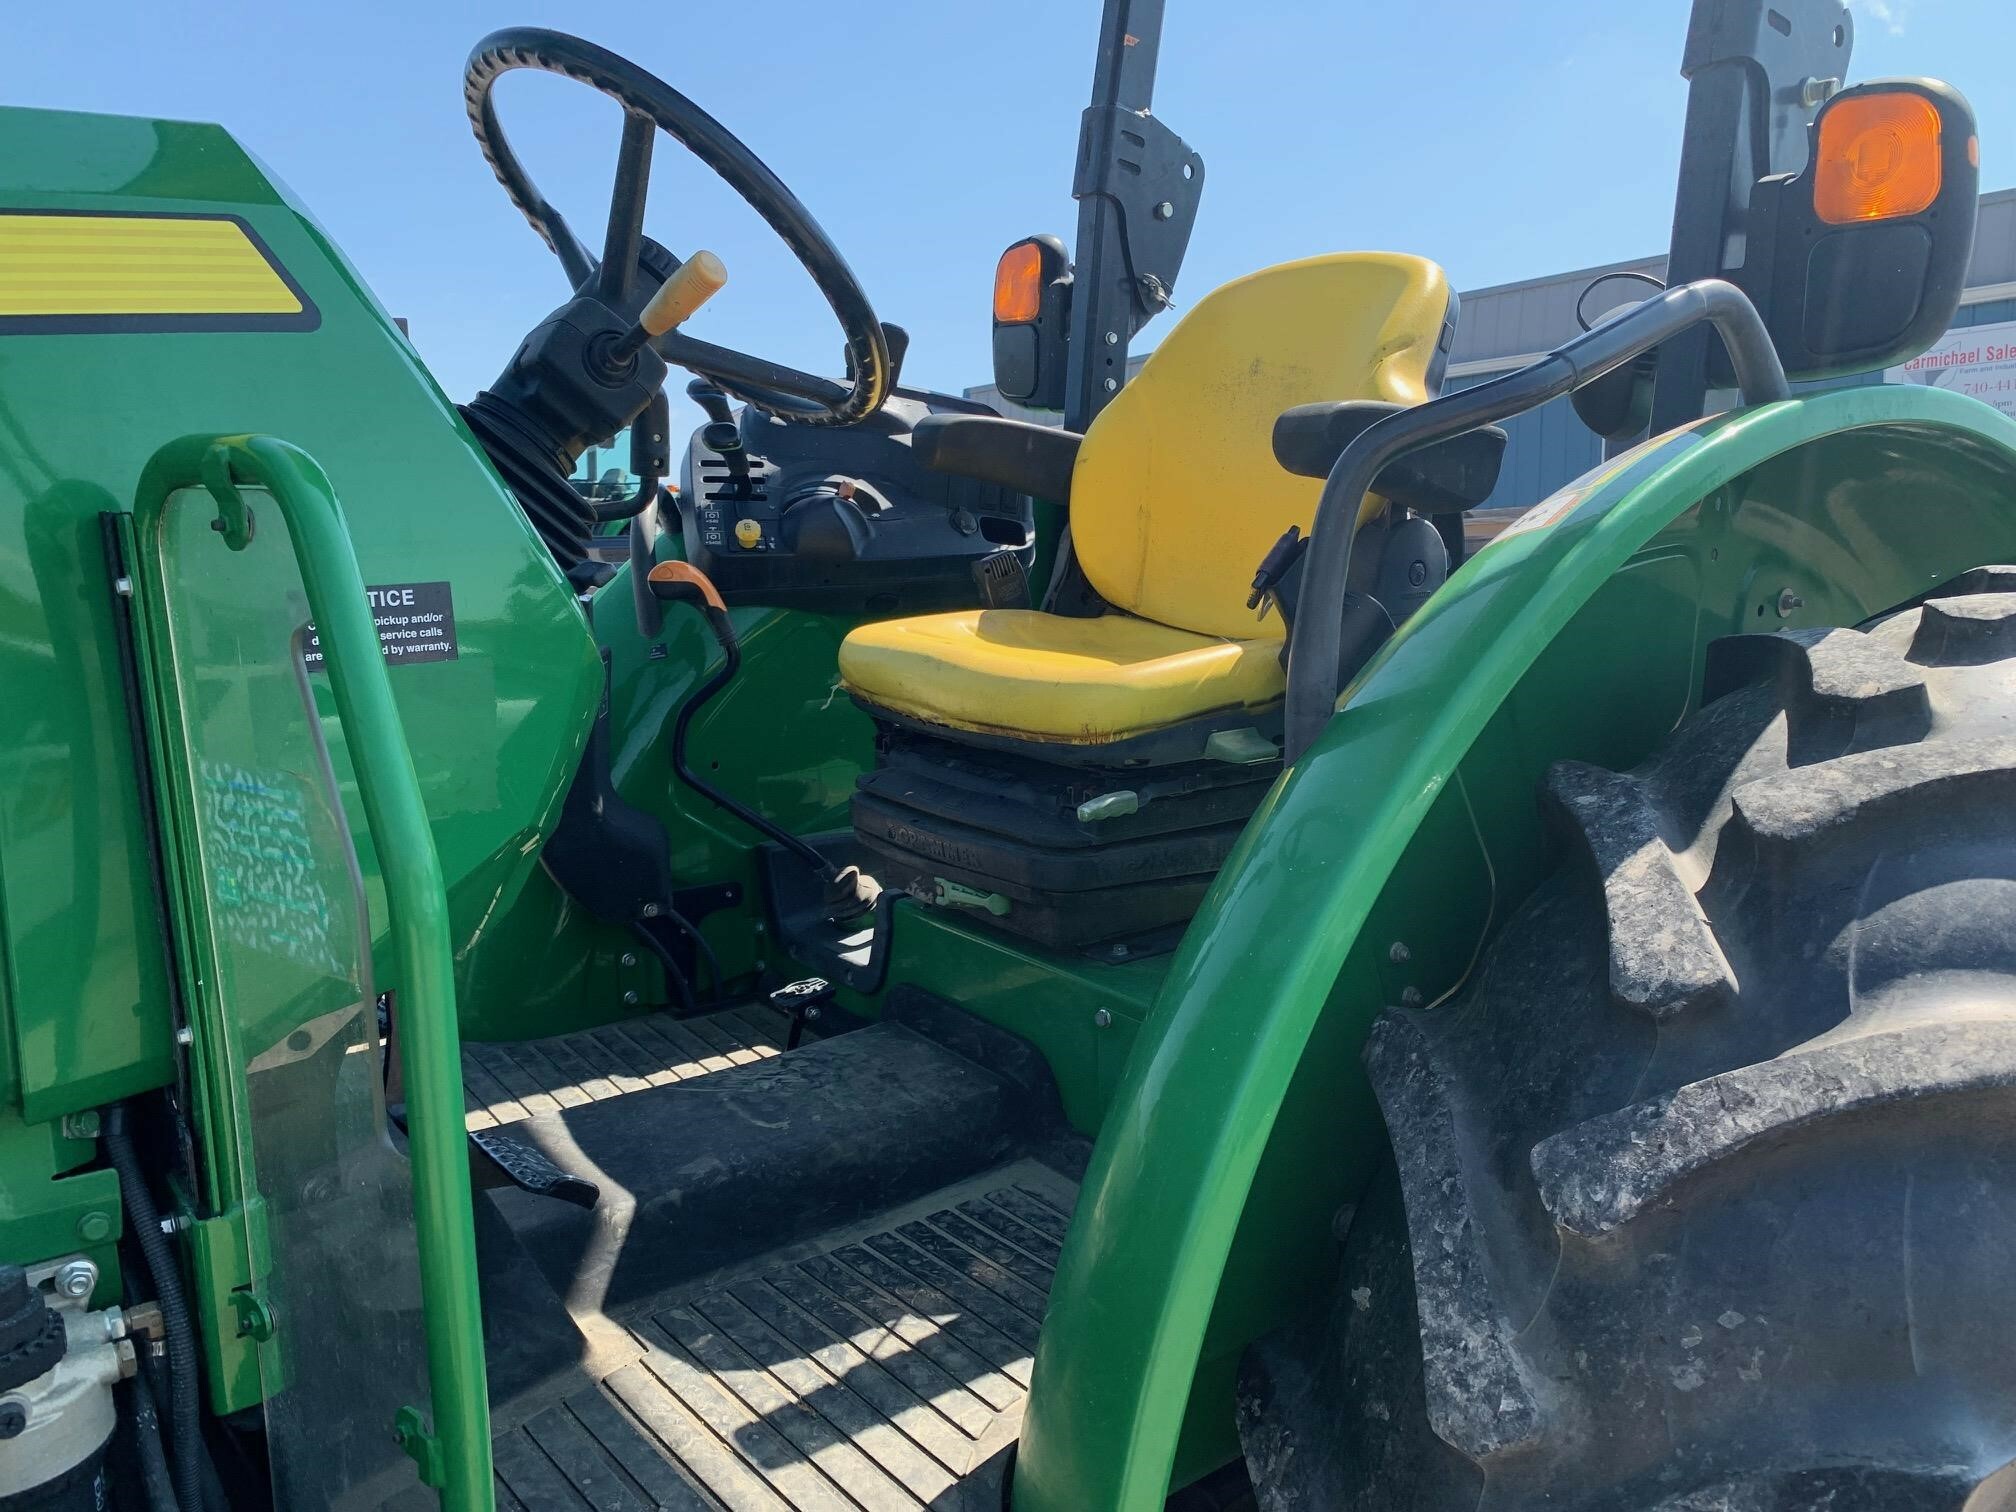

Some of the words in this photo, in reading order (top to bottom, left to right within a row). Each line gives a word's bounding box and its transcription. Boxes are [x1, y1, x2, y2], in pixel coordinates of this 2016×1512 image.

[367, 589, 415, 608] TICE
[374, 615, 409, 627] pickup
[411, 613, 444, 625] and/or
[380, 629, 418, 641] service
[419, 626, 443, 638] calls
[305, 653, 323, 661] are
[391, 645, 405, 656] by
[406, 641, 452, 653] warranty.
